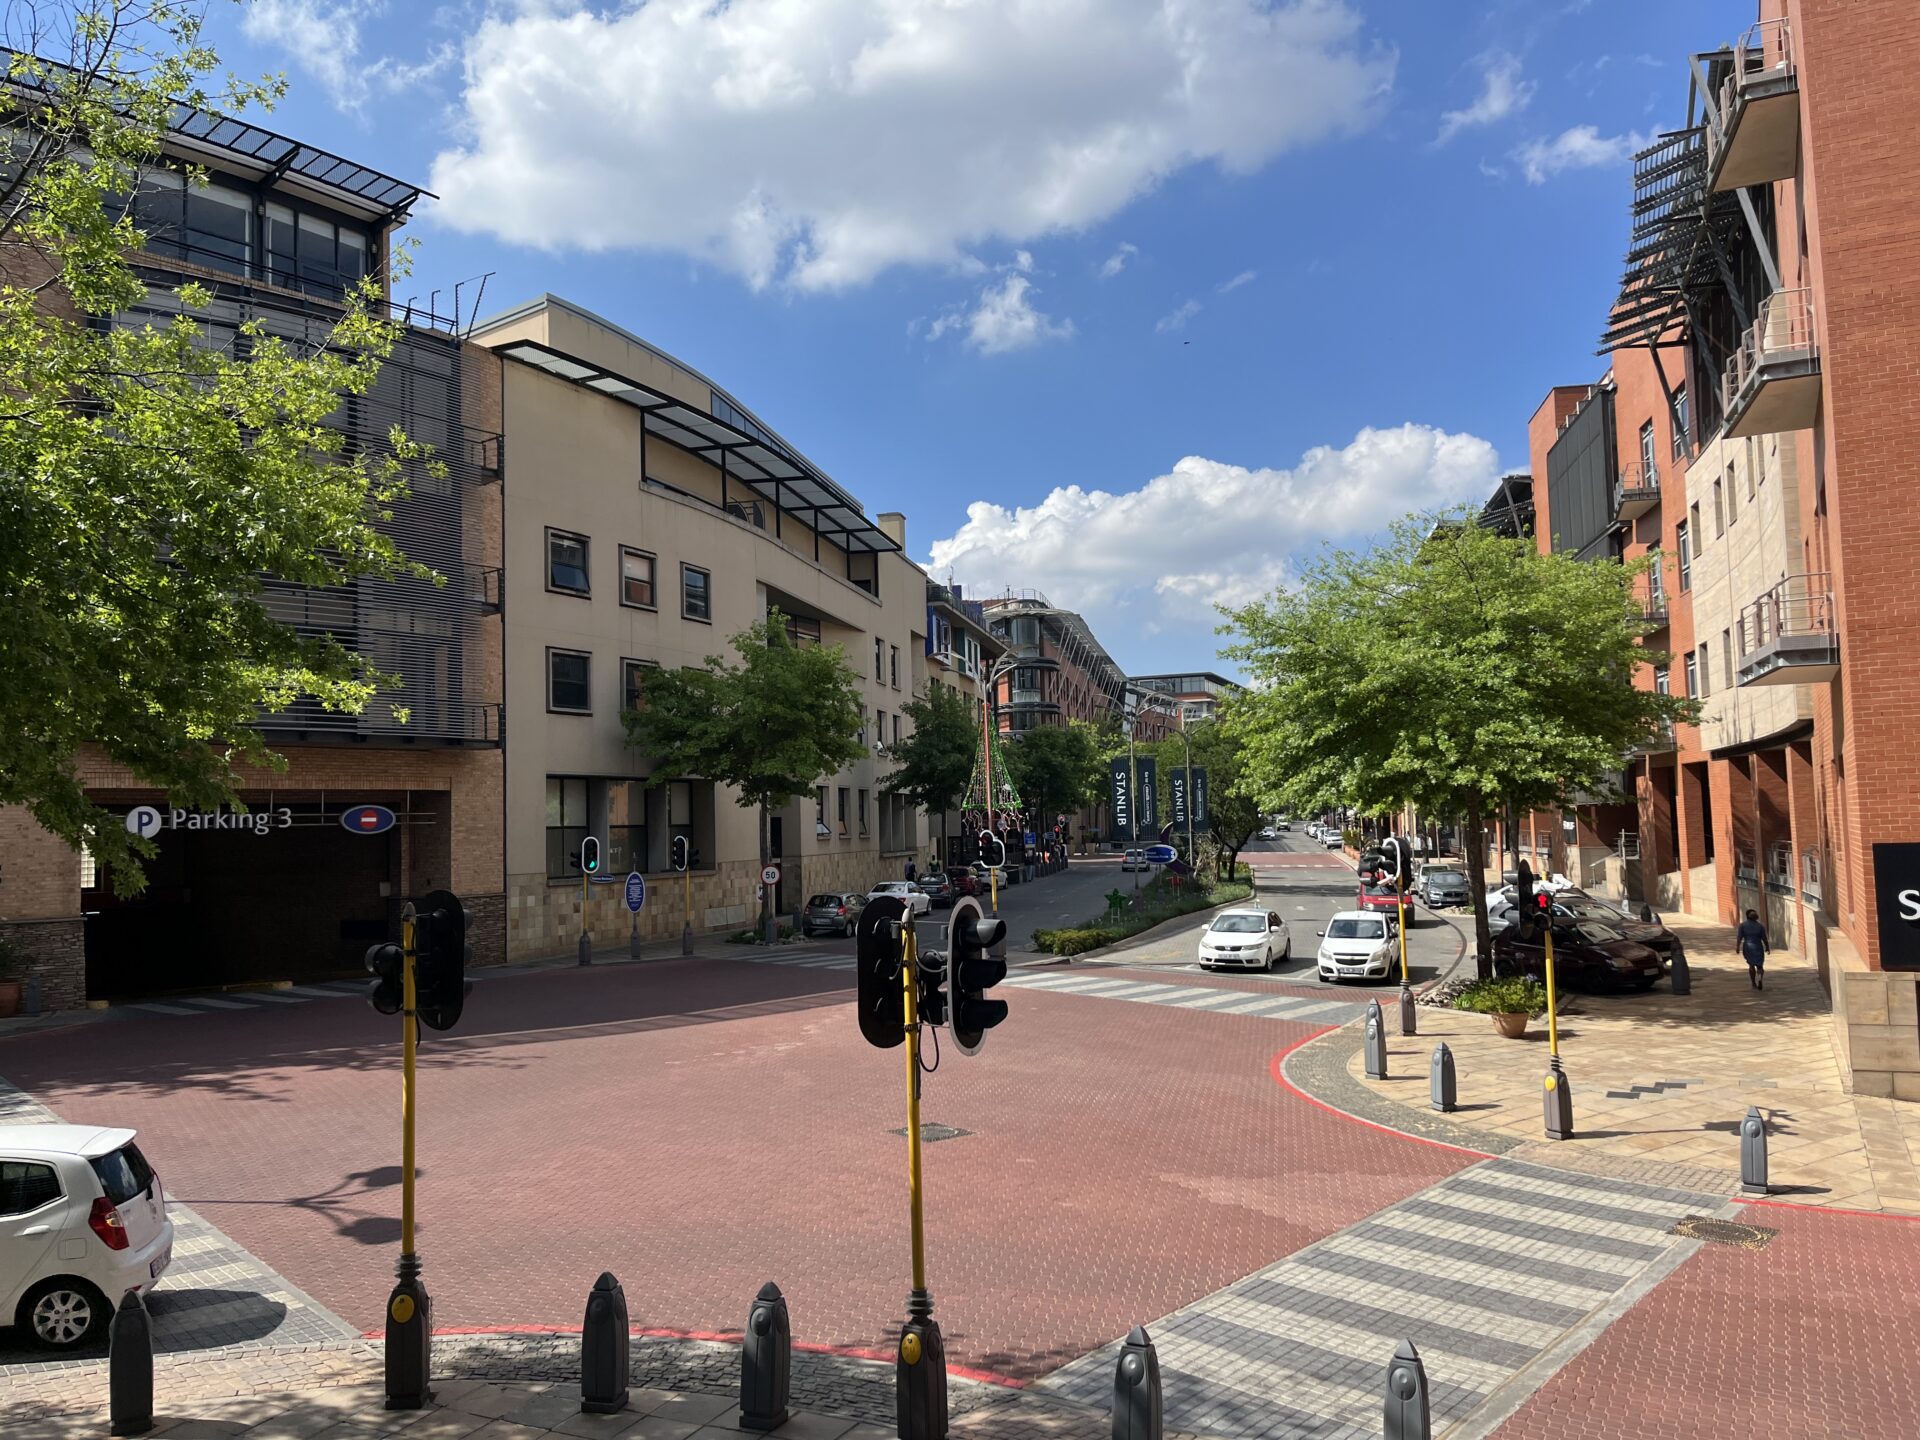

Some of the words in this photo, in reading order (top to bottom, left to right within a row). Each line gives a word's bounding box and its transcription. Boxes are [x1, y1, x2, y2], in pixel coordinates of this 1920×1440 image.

[1115, 772, 1127, 826] STANLIB
[1174, 779, 1184, 822] STANLIB
[137, 811, 154, 835] P
[171, 807, 270, 836] Parking
[277, 807, 292, 828] 3
[765, 871, 776, 880] 50
